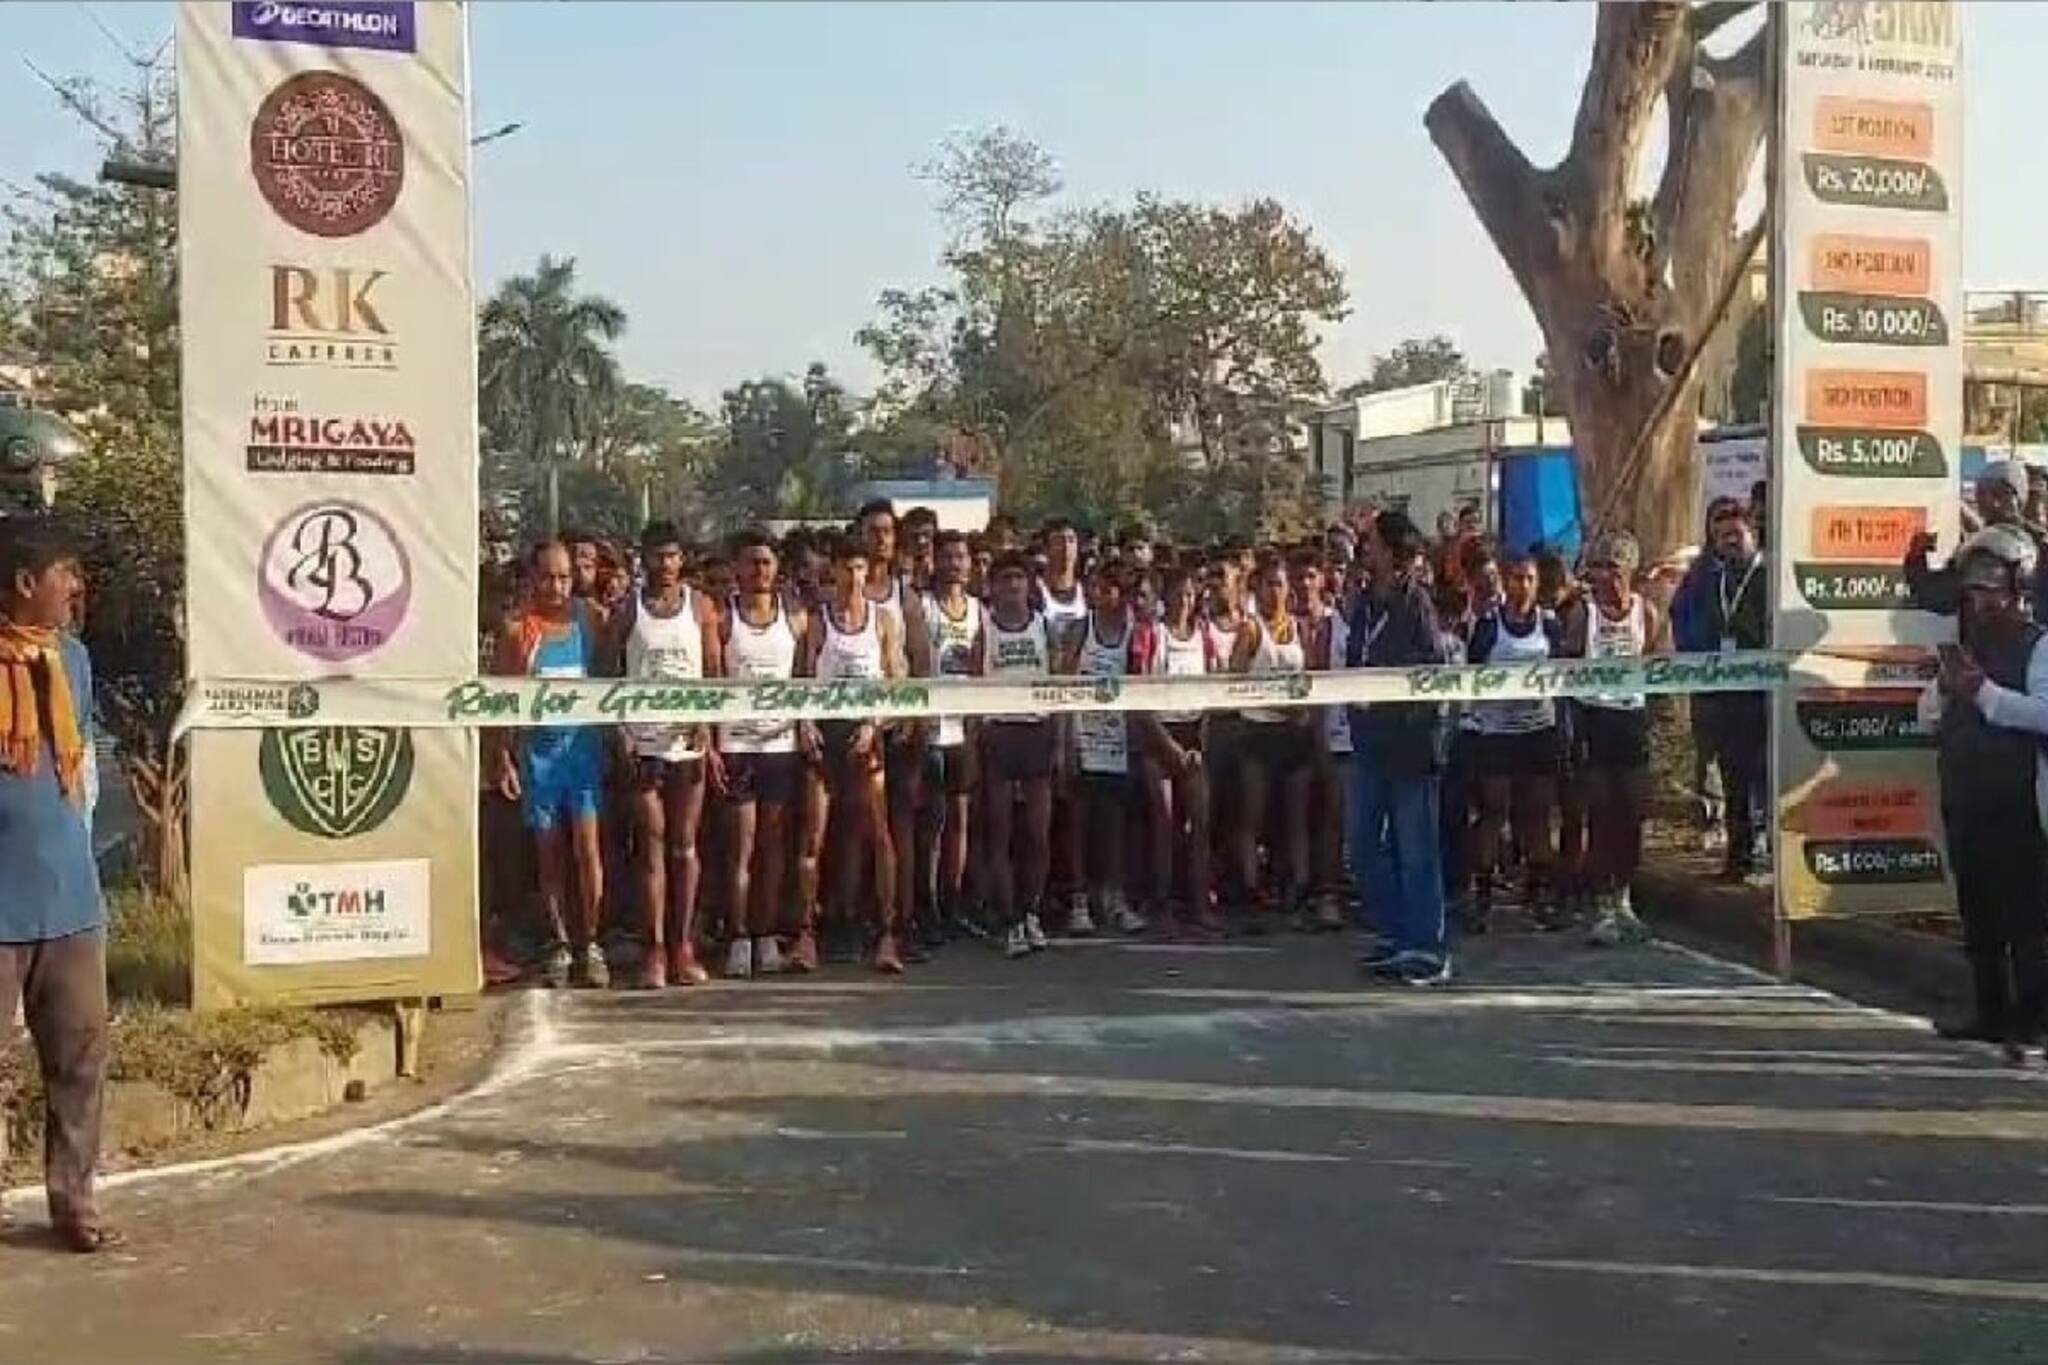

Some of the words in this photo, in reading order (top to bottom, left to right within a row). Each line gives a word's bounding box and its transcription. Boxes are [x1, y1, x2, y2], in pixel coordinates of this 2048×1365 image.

[281, 5, 397, 36] DECATHLON
[1858, 116, 1915, 139] POSITION
[272, 139, 358, 166] HOTEL
[1816, 165, 1843, 190] Rs.
[1851, 165, 1931, 196] 20,000/-
[1855, 253, 1915, 272] POSITION
[266, 265, 391, 334] RK
[1822, 307, 1852, 334] Rs.
[1857, 308, 1937, 337] 10,000/-
[251, 416, 415, 447] MRIGAYA
[1818, 438, 1846, 462] Rs.
[1805, 577, 1831, 598] Rs.
[1407, 669, 1461, 695] Run
[1472, 664, 1509, 695] for
[447, 681, 519, 718] Run
[530, 682, 586, 720] for
[599, 681, 741, 720] Greener
[1811, 719, 1835, 737] Rs.
[319, 889, 385, 914] TMH
